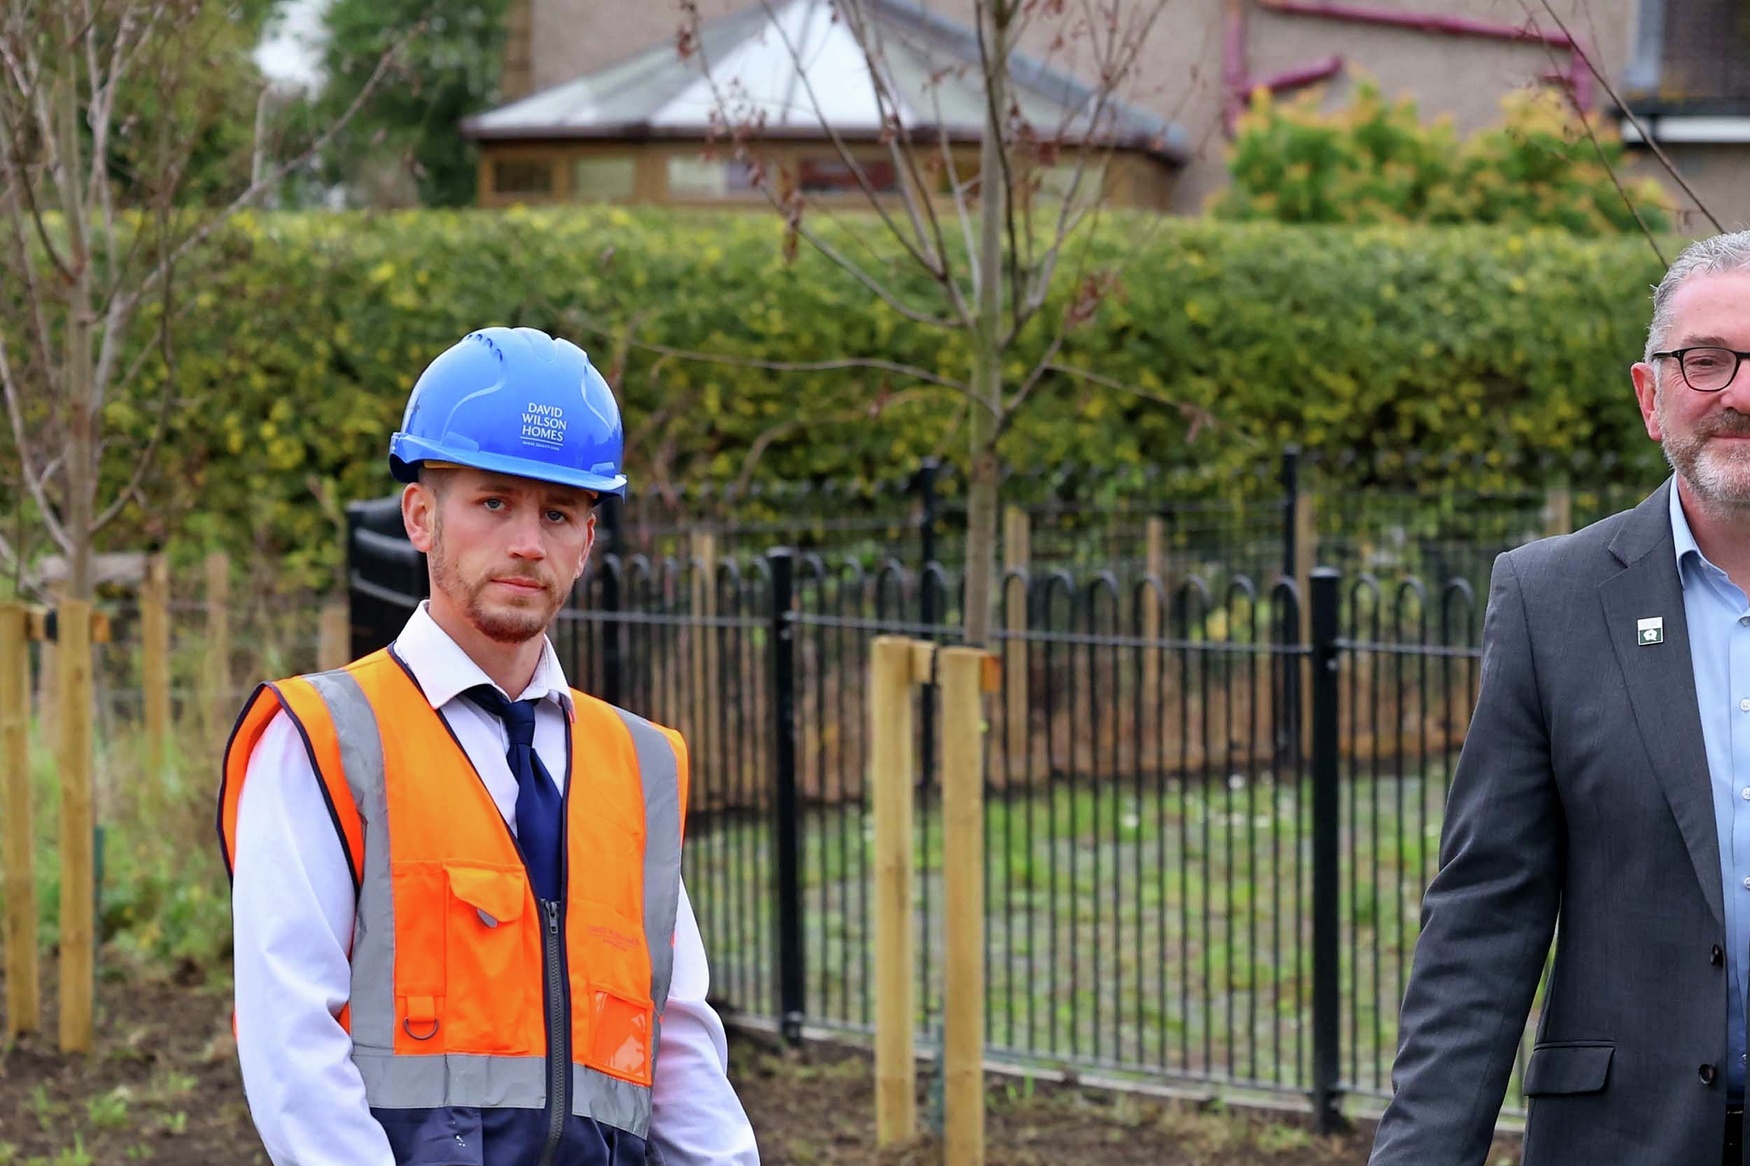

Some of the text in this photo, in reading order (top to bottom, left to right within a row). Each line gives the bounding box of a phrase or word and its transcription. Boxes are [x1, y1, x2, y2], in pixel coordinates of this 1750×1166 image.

[528, 402, 563, 418] DAVID
[522, 412, 567, 431] WILSON
[522, 424, 564, 442] HOMES
